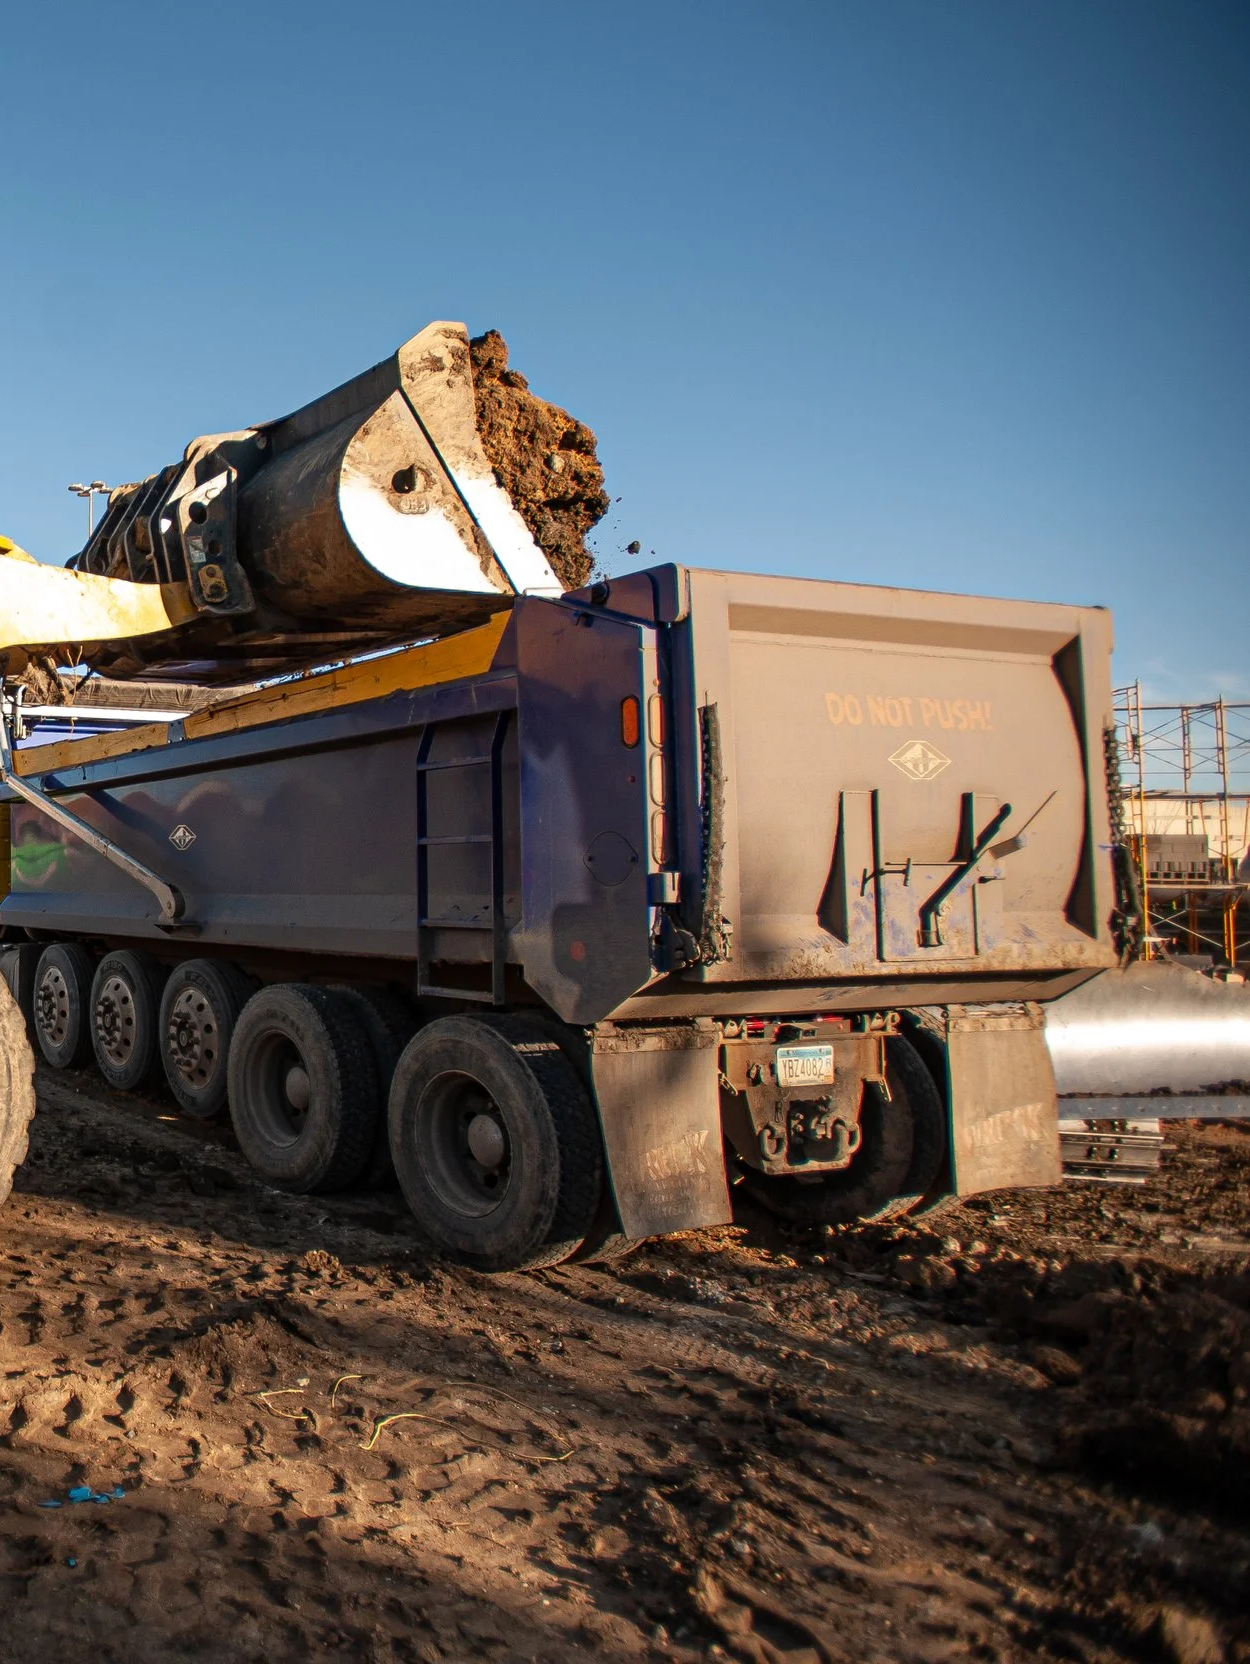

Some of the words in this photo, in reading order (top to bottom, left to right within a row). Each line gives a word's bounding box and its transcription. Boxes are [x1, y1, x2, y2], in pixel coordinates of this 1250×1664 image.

[824, 692, 864, 726] DO
[866, 695, 914, 728] NOT
[920, 698, 994, 731] PUSH!
[781, 1058, 824, 1078] YBZ4082
